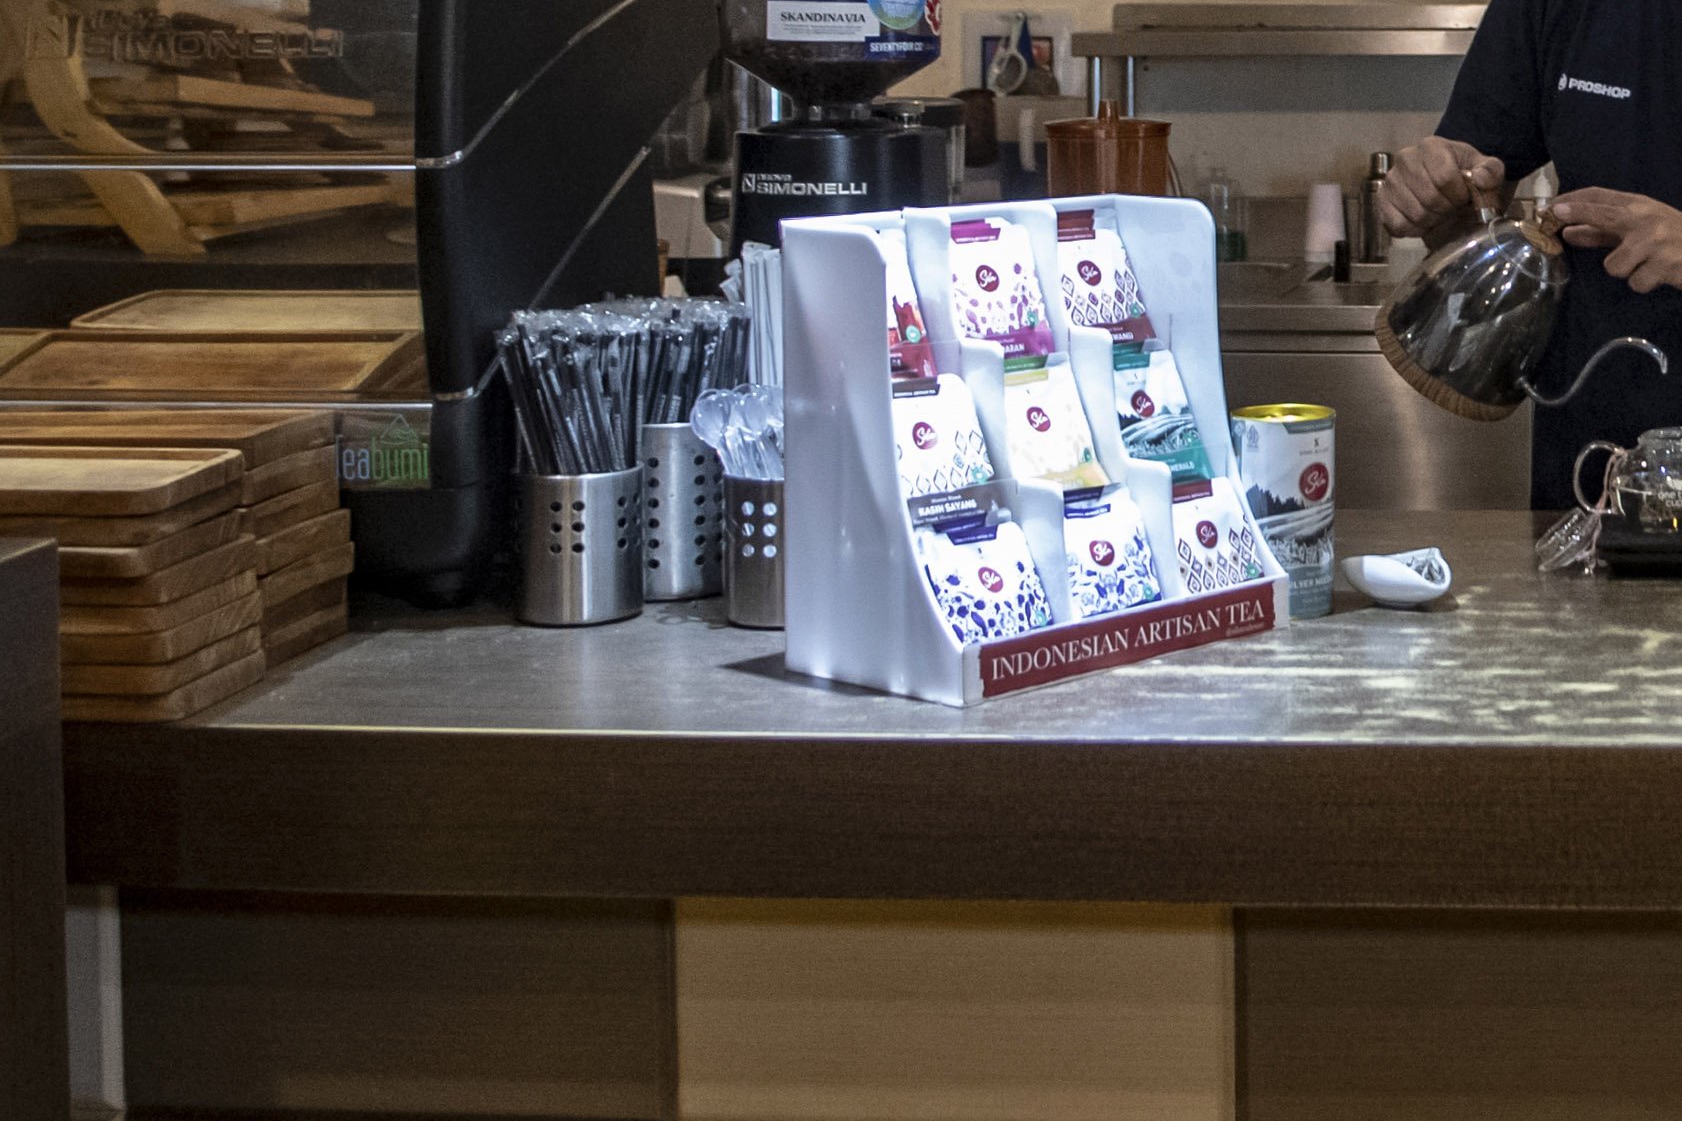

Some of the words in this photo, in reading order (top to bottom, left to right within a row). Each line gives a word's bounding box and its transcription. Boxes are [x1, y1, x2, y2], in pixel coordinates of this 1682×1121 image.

[780, 12, 867, 24] SKANDINAVIA
[1569, 77, 1632, 100] PROSHOP
[757, 182, 868, 195] SIMONELLI
[917, 503, 944, 517] KASIH
[991, 627, 1129, 681] INDONESIAN
[1134, 607, 1221, 648] ARTISAN
[1225, 599, 1265, 625] TEA
